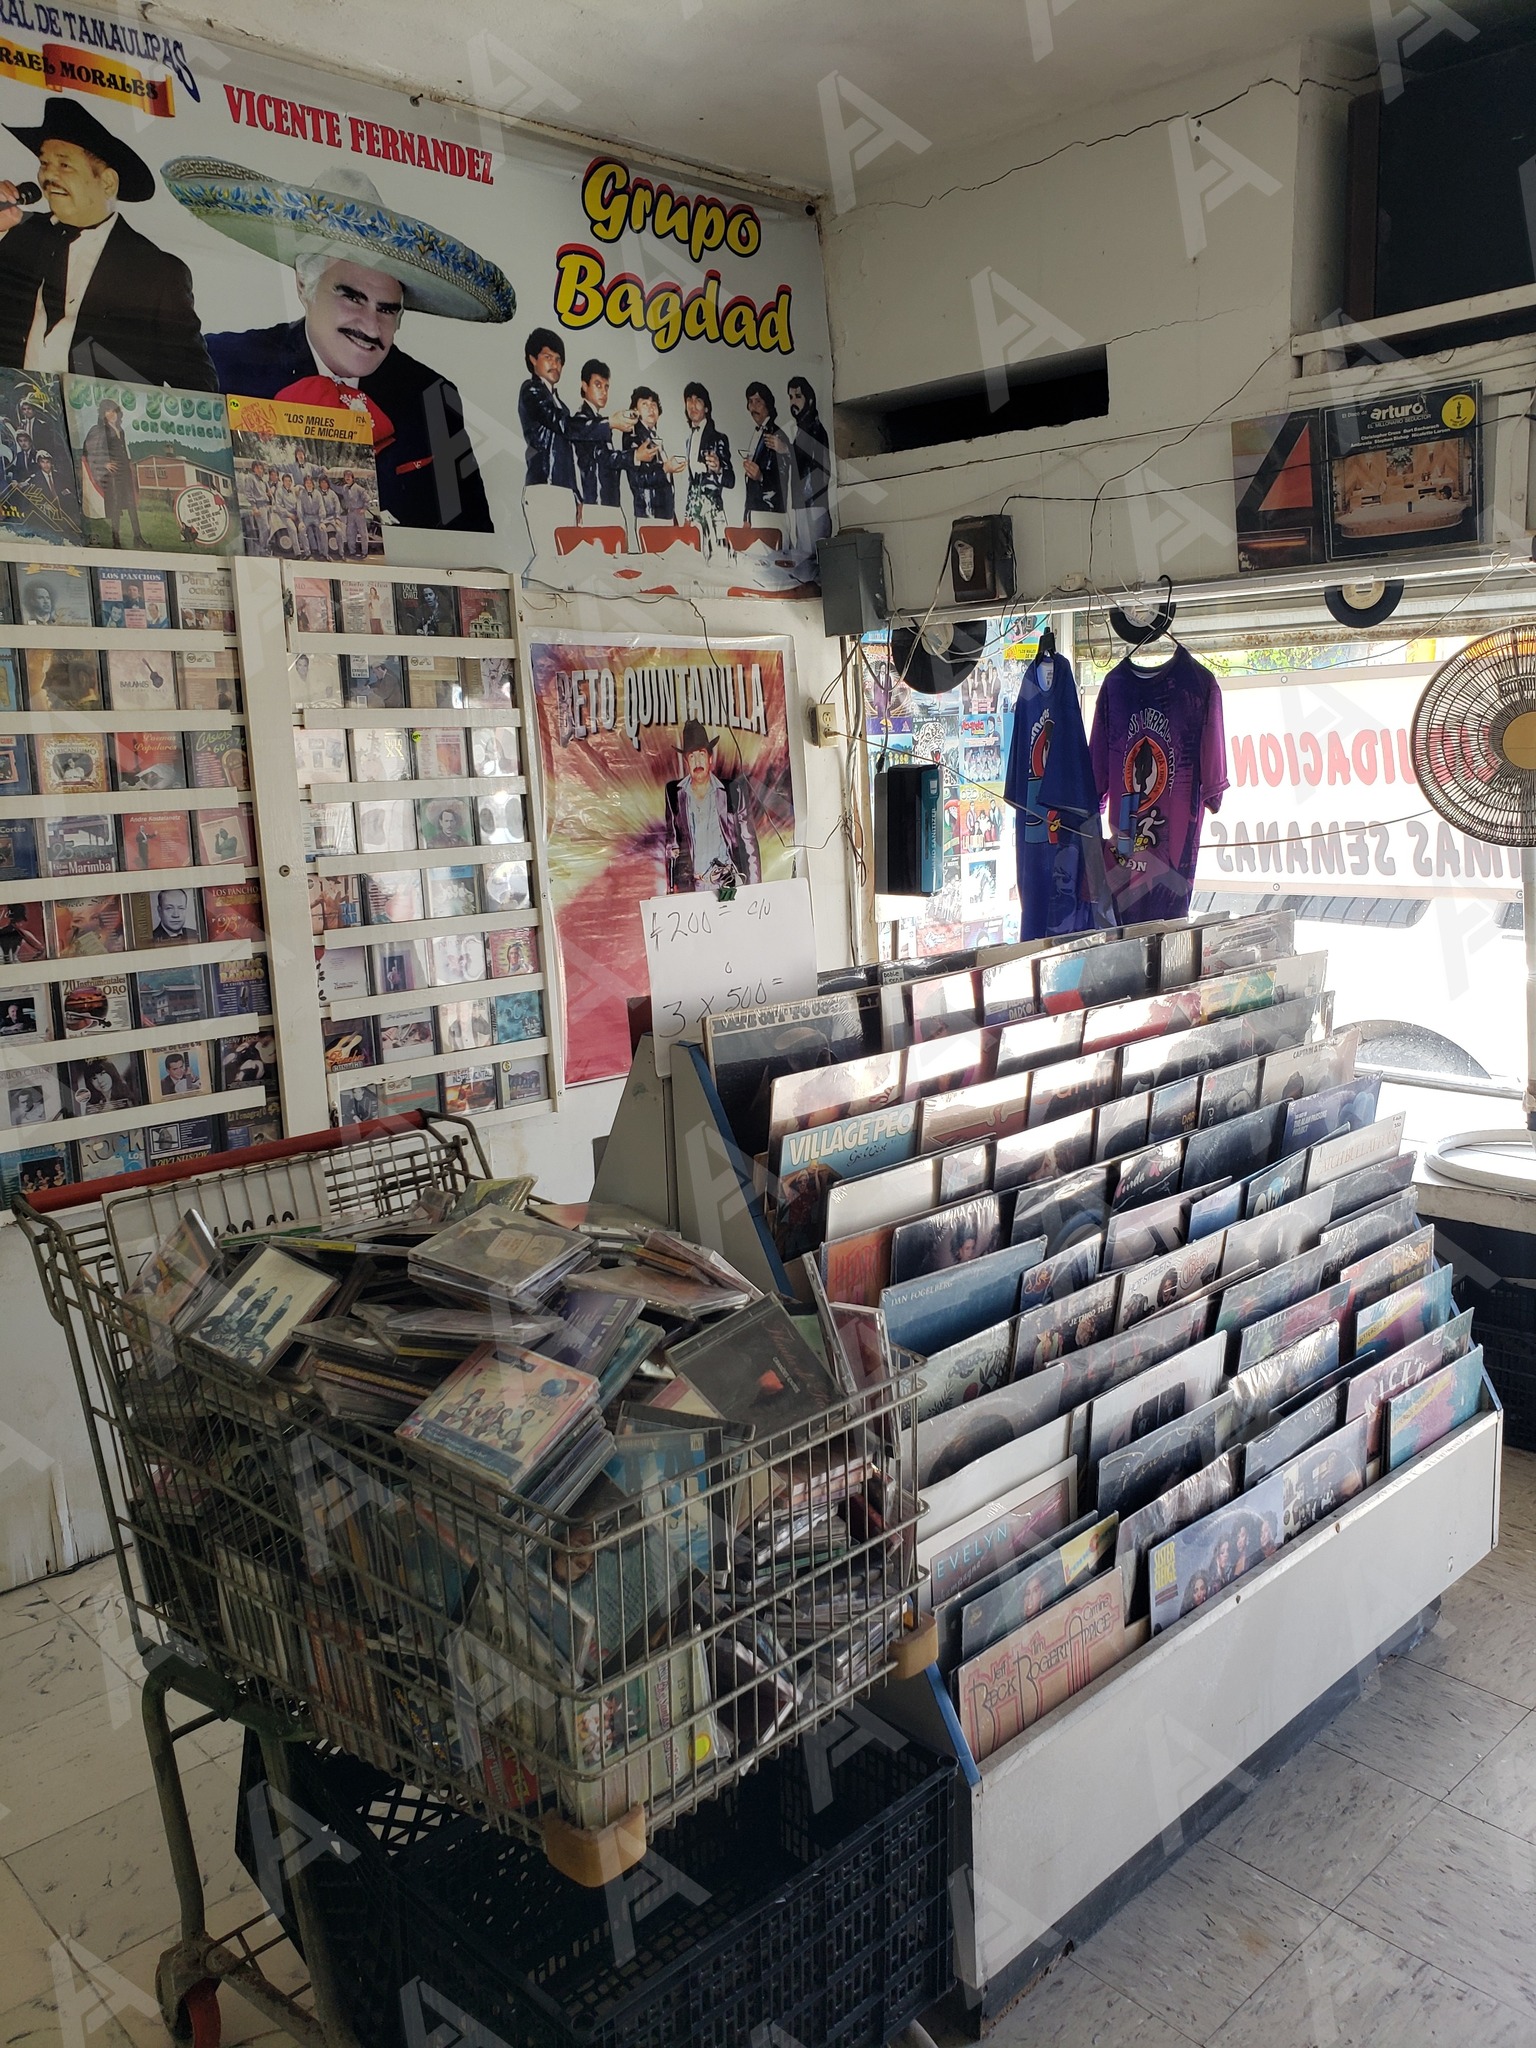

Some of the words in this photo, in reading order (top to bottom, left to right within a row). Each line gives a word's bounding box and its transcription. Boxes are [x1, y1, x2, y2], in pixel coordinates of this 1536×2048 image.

[35, 4, 62, 37] DE
[63, 10, 200, 103] TAMAULIPAS
[60, 59, 158, 100] MORALES
[223, 84, 342, 148] VICENTE
[348, 116, 494, 185] FERNANDEZ
[582, 156, 761, 261] Grupo
[555, 243, 795, 355] Bagdad
[306, 416, 334, 427] MALES
[1370, 402, 1424, 420] arturo
[304, 426, 316, 436] DE
[102, 572, 119, 580] LOS
[120, 573, 161, 581] PANCHOS
[556, 668, 617, 748] BETO
[624, 664, 768, 751] QUINTANILLA
[930, 807, 938, 846] SANITIZER
[68, 861, 112, 874] Marimba
[212, 888, 226, 897] LOS
[62, 979, 76, 996] 20
[103, 984, 127, 995] ORO
[659, 1001, 686, 1038] 3
[725, 978, 767, 1012] 500
[789, 1120, 871, 1167] VILLAGE
[873, 1106, 916, 1142] PEO
[910, 1280, 953, 1299] FOGELBERG
[936, 1522, 1009, 1579] EVELYN
